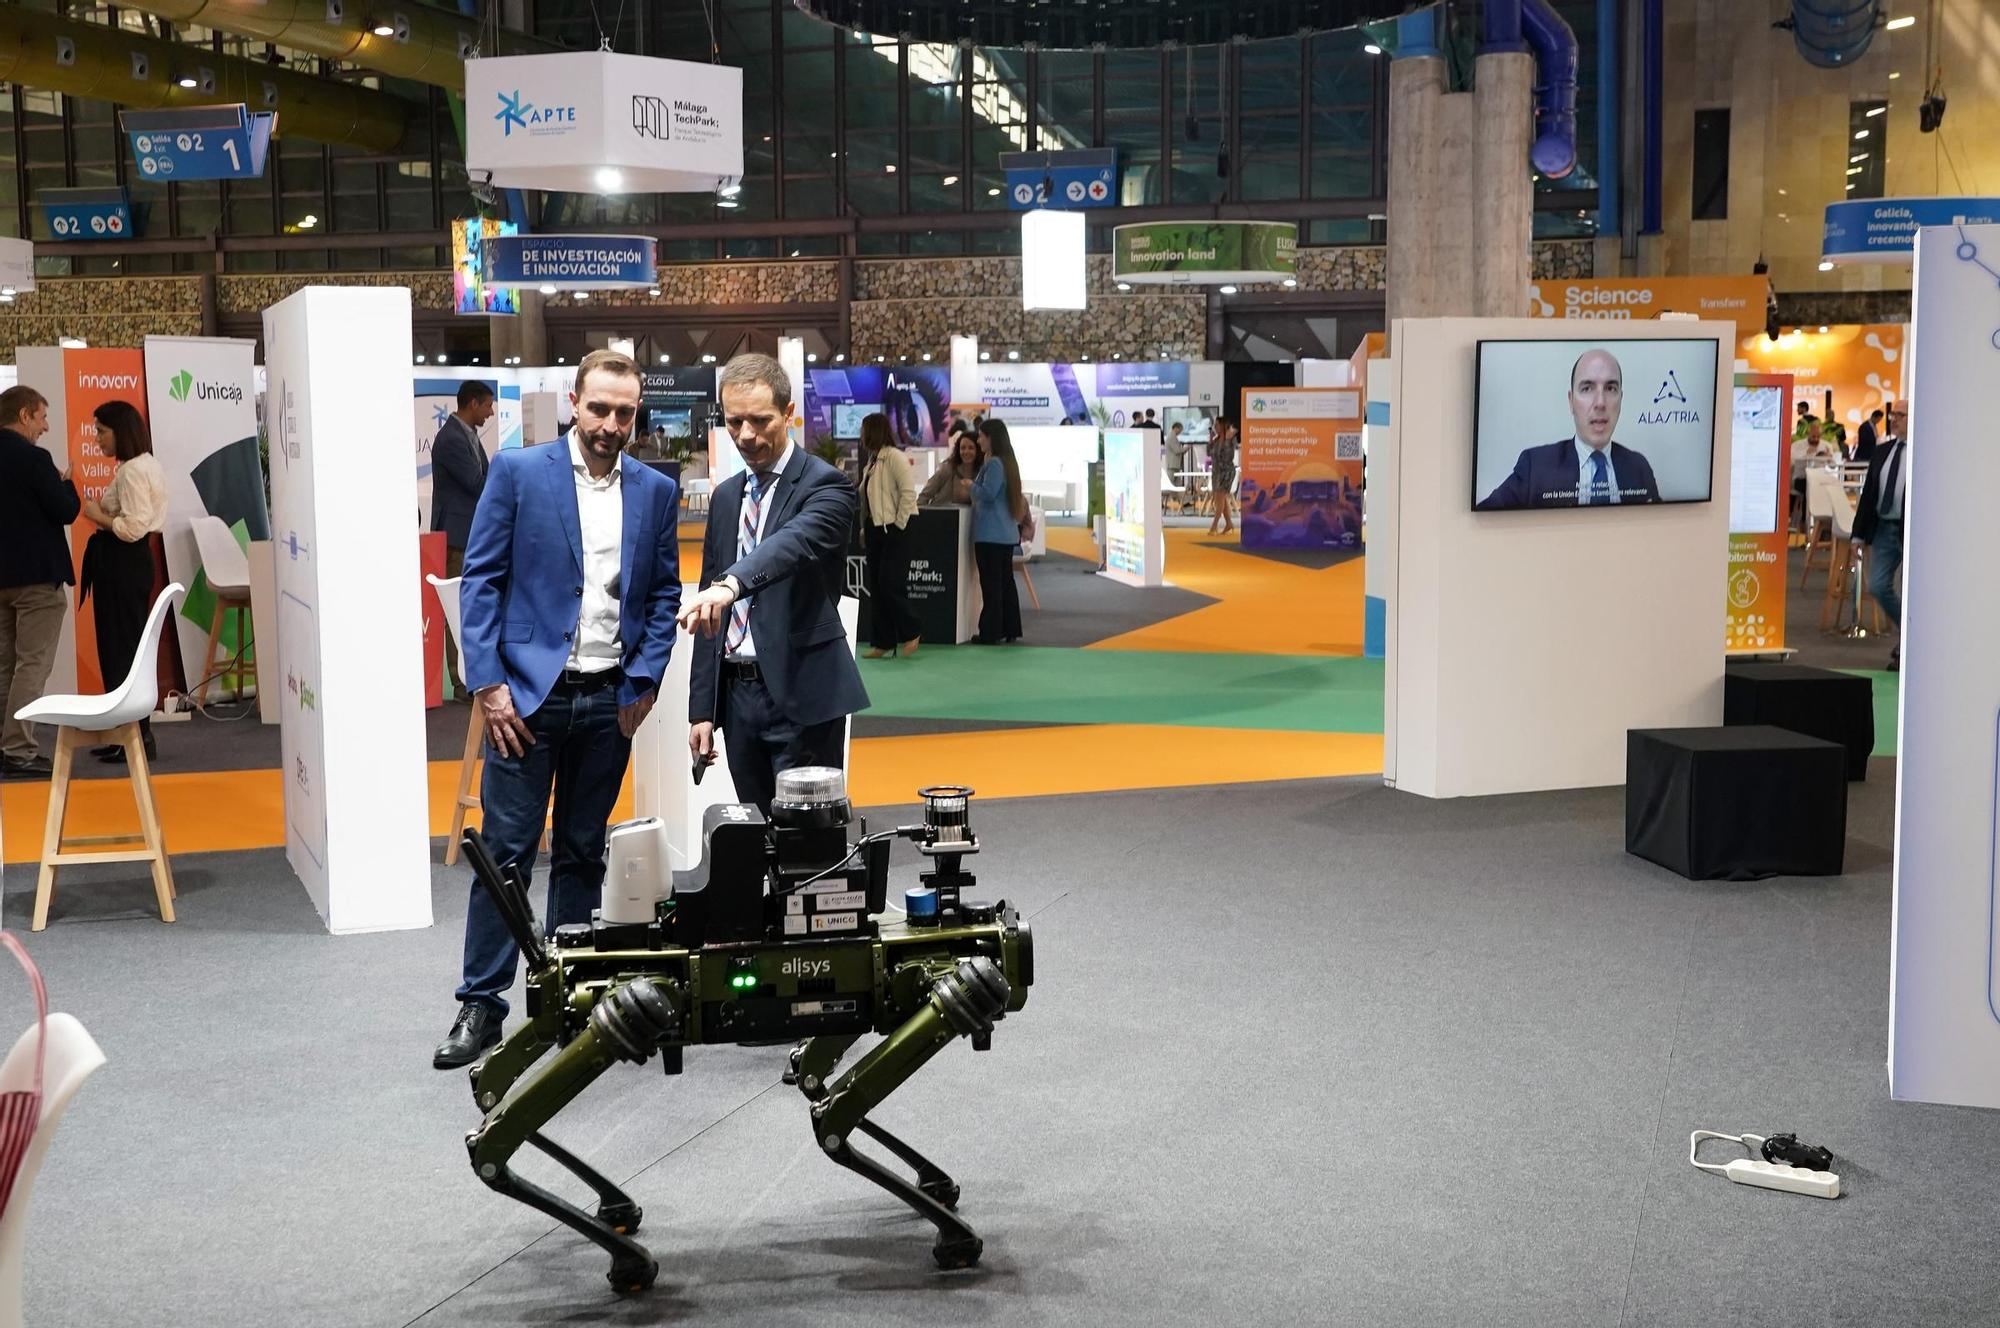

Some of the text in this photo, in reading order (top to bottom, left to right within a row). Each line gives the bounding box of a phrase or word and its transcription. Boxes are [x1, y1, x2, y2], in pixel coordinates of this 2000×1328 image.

[674, 100, 708, 114] Málaga
[530, 107, 576, 123] APTE
[192, 132, 205, 152] 2
[222, 138, 241, 172] 1
[1035, 183, 1049, 204] 2
[1874, 207, 1913, 219] Galicia,
[69, 216, 81, 234] 2
[1867, 220, 1921, 232] innovando
[522, 248, 642, 265] DE INVESTIGACIÓN
[1130, 247, 1216, 262] Innovation land
[522, 260, 620, 275] E INNOVACIÓN
[1564, 286, 1653, 306] Science
[647, 377, 675, 387] CLOUD
[196, 381, 243, 406] Unicaja
[1792, 384, 1833, 397] ence
[998, 398, 1011, 406] GO
[1012, 398, 1020, 406] to
[1021, 398, 1047, 406] market
[80, 421, 98, 437] Ins
[1248, 426, 1308, 436] Demographics,
[1248, 437, 1318, 447] entrepreneurship
[1248, 447, 1309, 456] and technology
[82, 462, 111, 478] Valle
[1559, 490, 1575, 499] Unión
[1624, 488, 1648, 496] relevante
[1728, 551, 1777, 564] bitors Map
[910, 560, 929, 570] aga
[908, 570, 943, 584] hPark;
[781, 957, 831, 979] alisys
